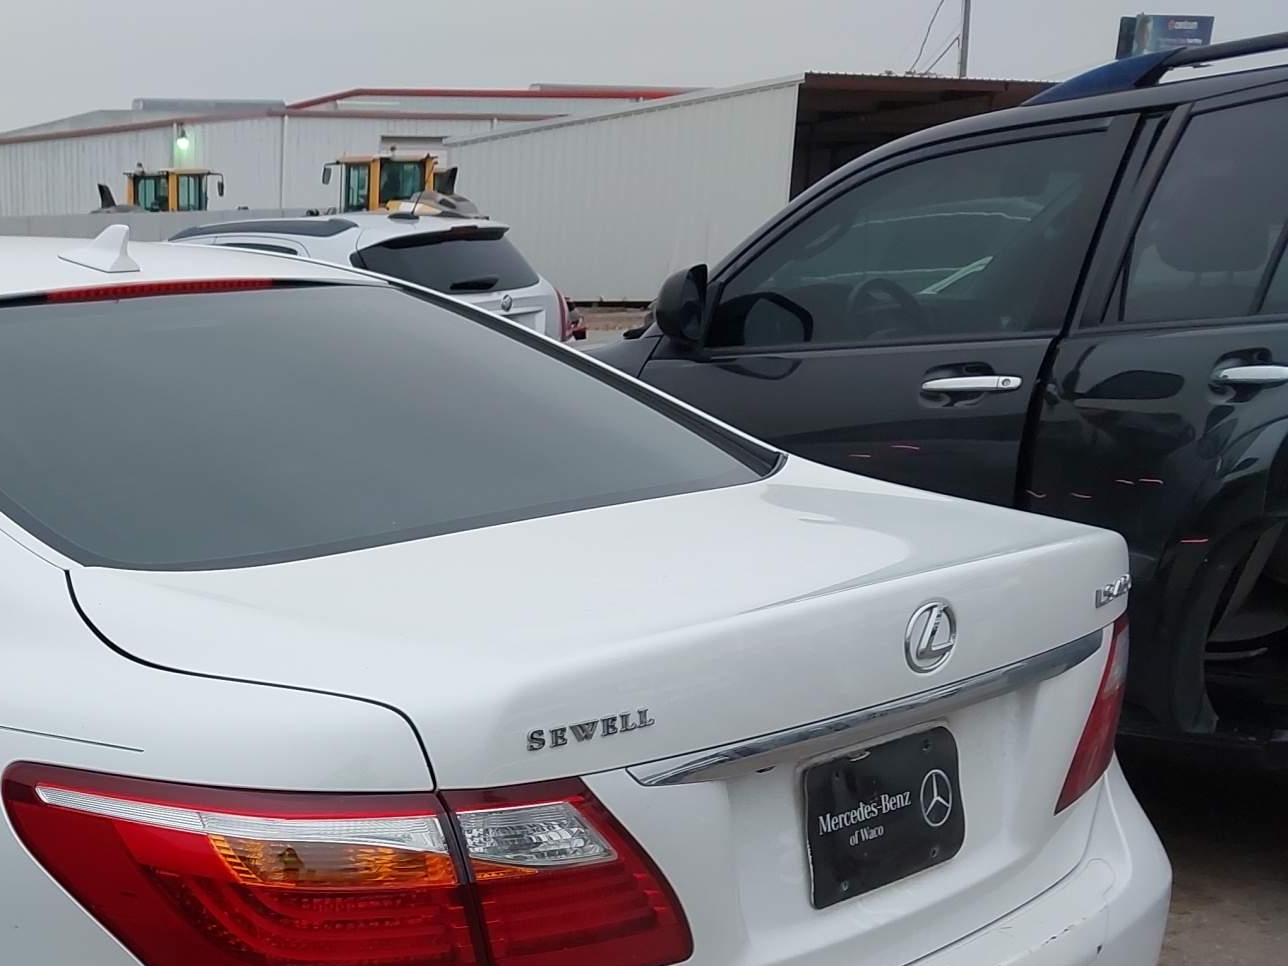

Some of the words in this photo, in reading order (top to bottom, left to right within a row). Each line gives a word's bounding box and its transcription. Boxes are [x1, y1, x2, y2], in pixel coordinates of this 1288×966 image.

[527, 708, 655, 751] SEWELL
[818, 791, 911, 835] Mercedes-Benz
[849, 831, 859, 846] of
[860, 826, 884, 841] Waco
